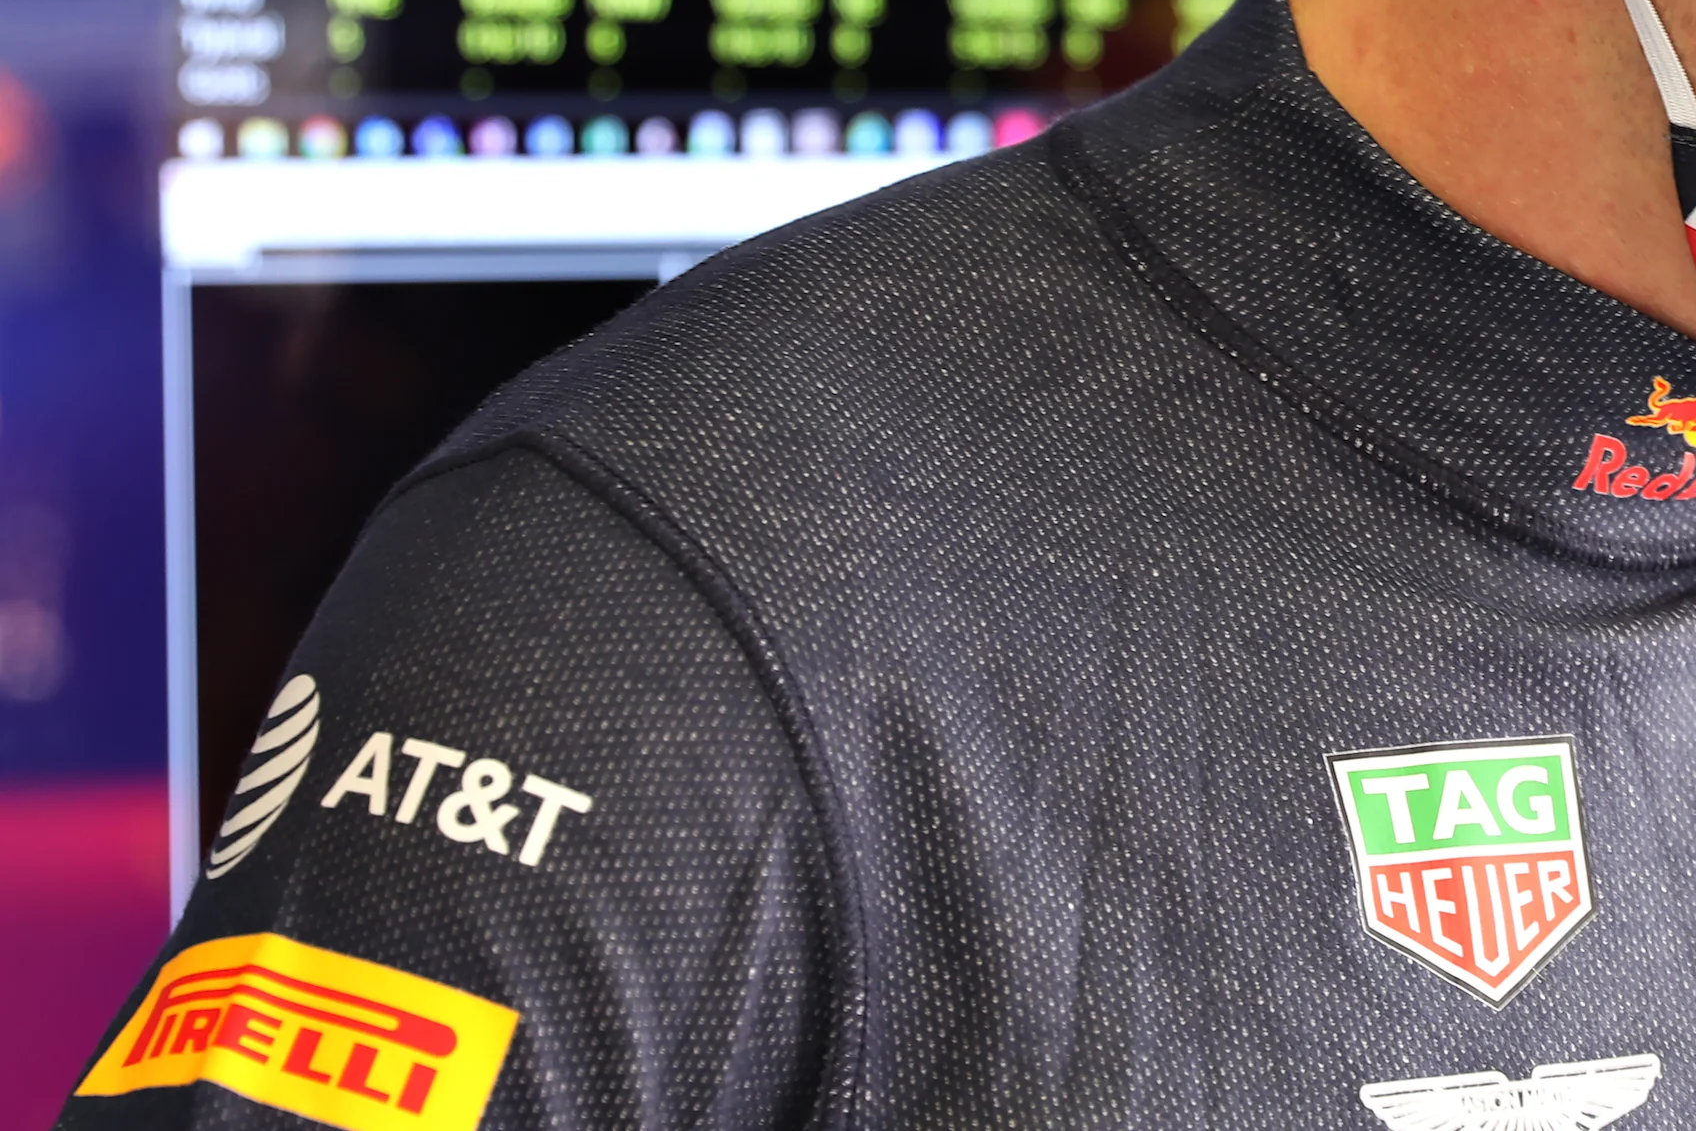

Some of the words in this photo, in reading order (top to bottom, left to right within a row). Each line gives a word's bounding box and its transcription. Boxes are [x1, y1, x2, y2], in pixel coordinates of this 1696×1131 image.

[1571, 433, 1696, 501] Red
[321, 731, 592, 867] AT&T
[1362, 765, 1556, 844] TAG
[1376, 859, 1574, 978] HEUER
[121, 964, 457, 1117] PIRELLI
